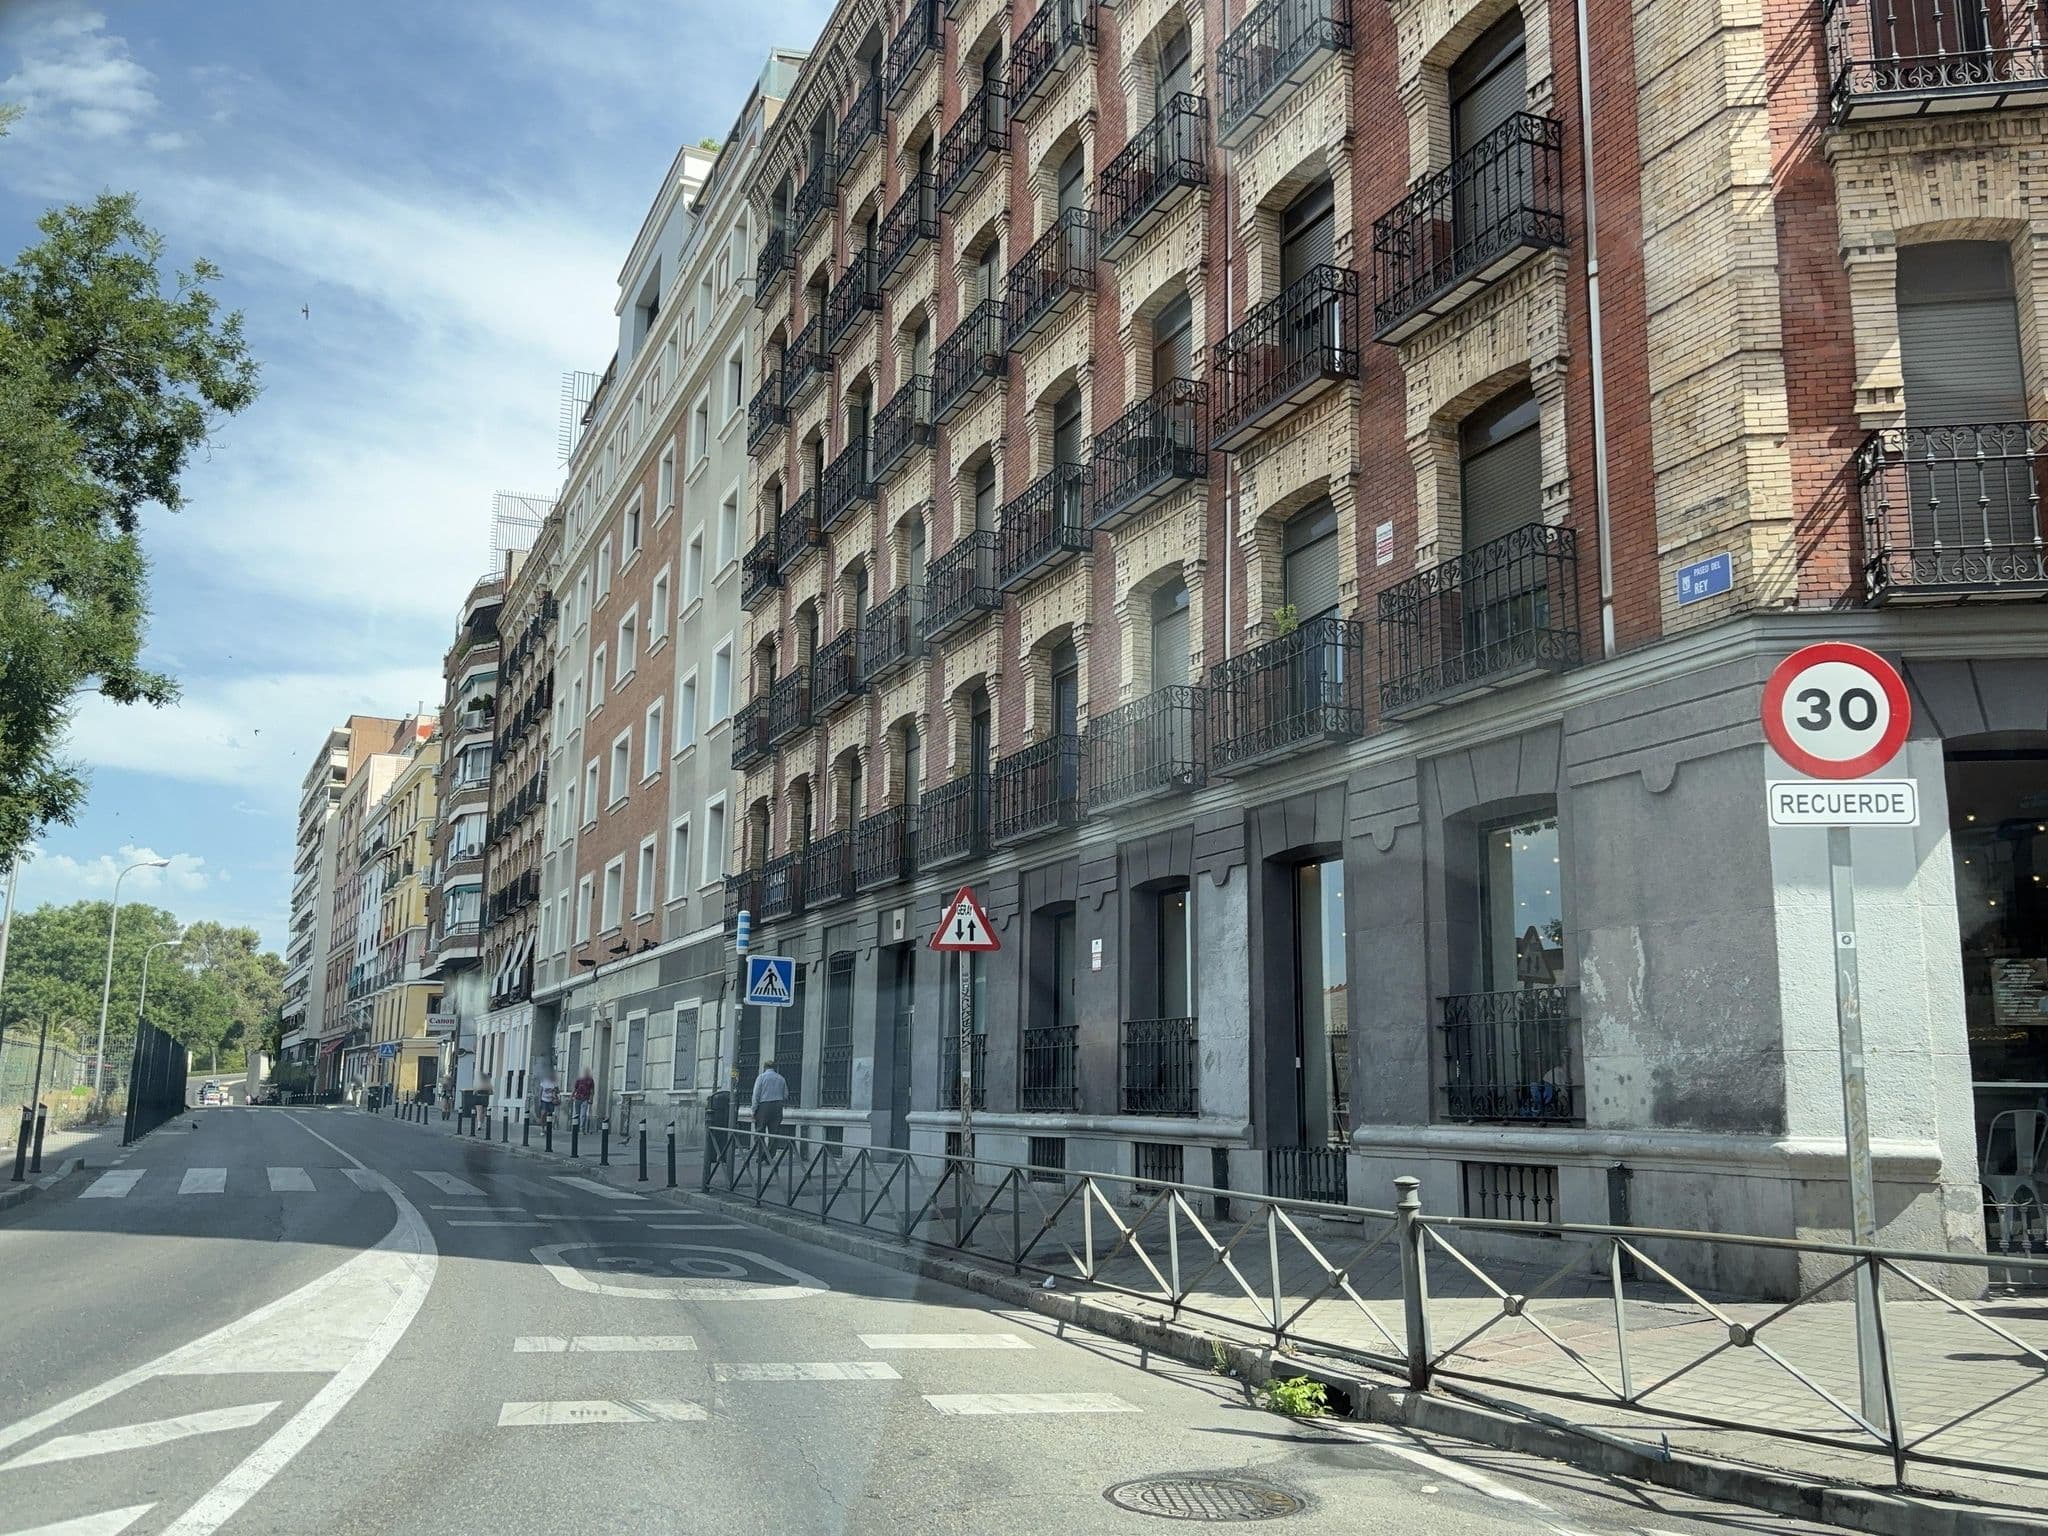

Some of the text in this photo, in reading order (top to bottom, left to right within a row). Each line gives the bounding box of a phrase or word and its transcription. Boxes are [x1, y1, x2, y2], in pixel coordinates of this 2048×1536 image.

[1694, 561, 1721, 576] PASEO DEL
[1695, 579, 1708, 594] REY
[1796, 687, 1878, 731] 30
[1780, 794, 1905, 813] RECUERDE
[597, 1256, 748, 1278] 30
